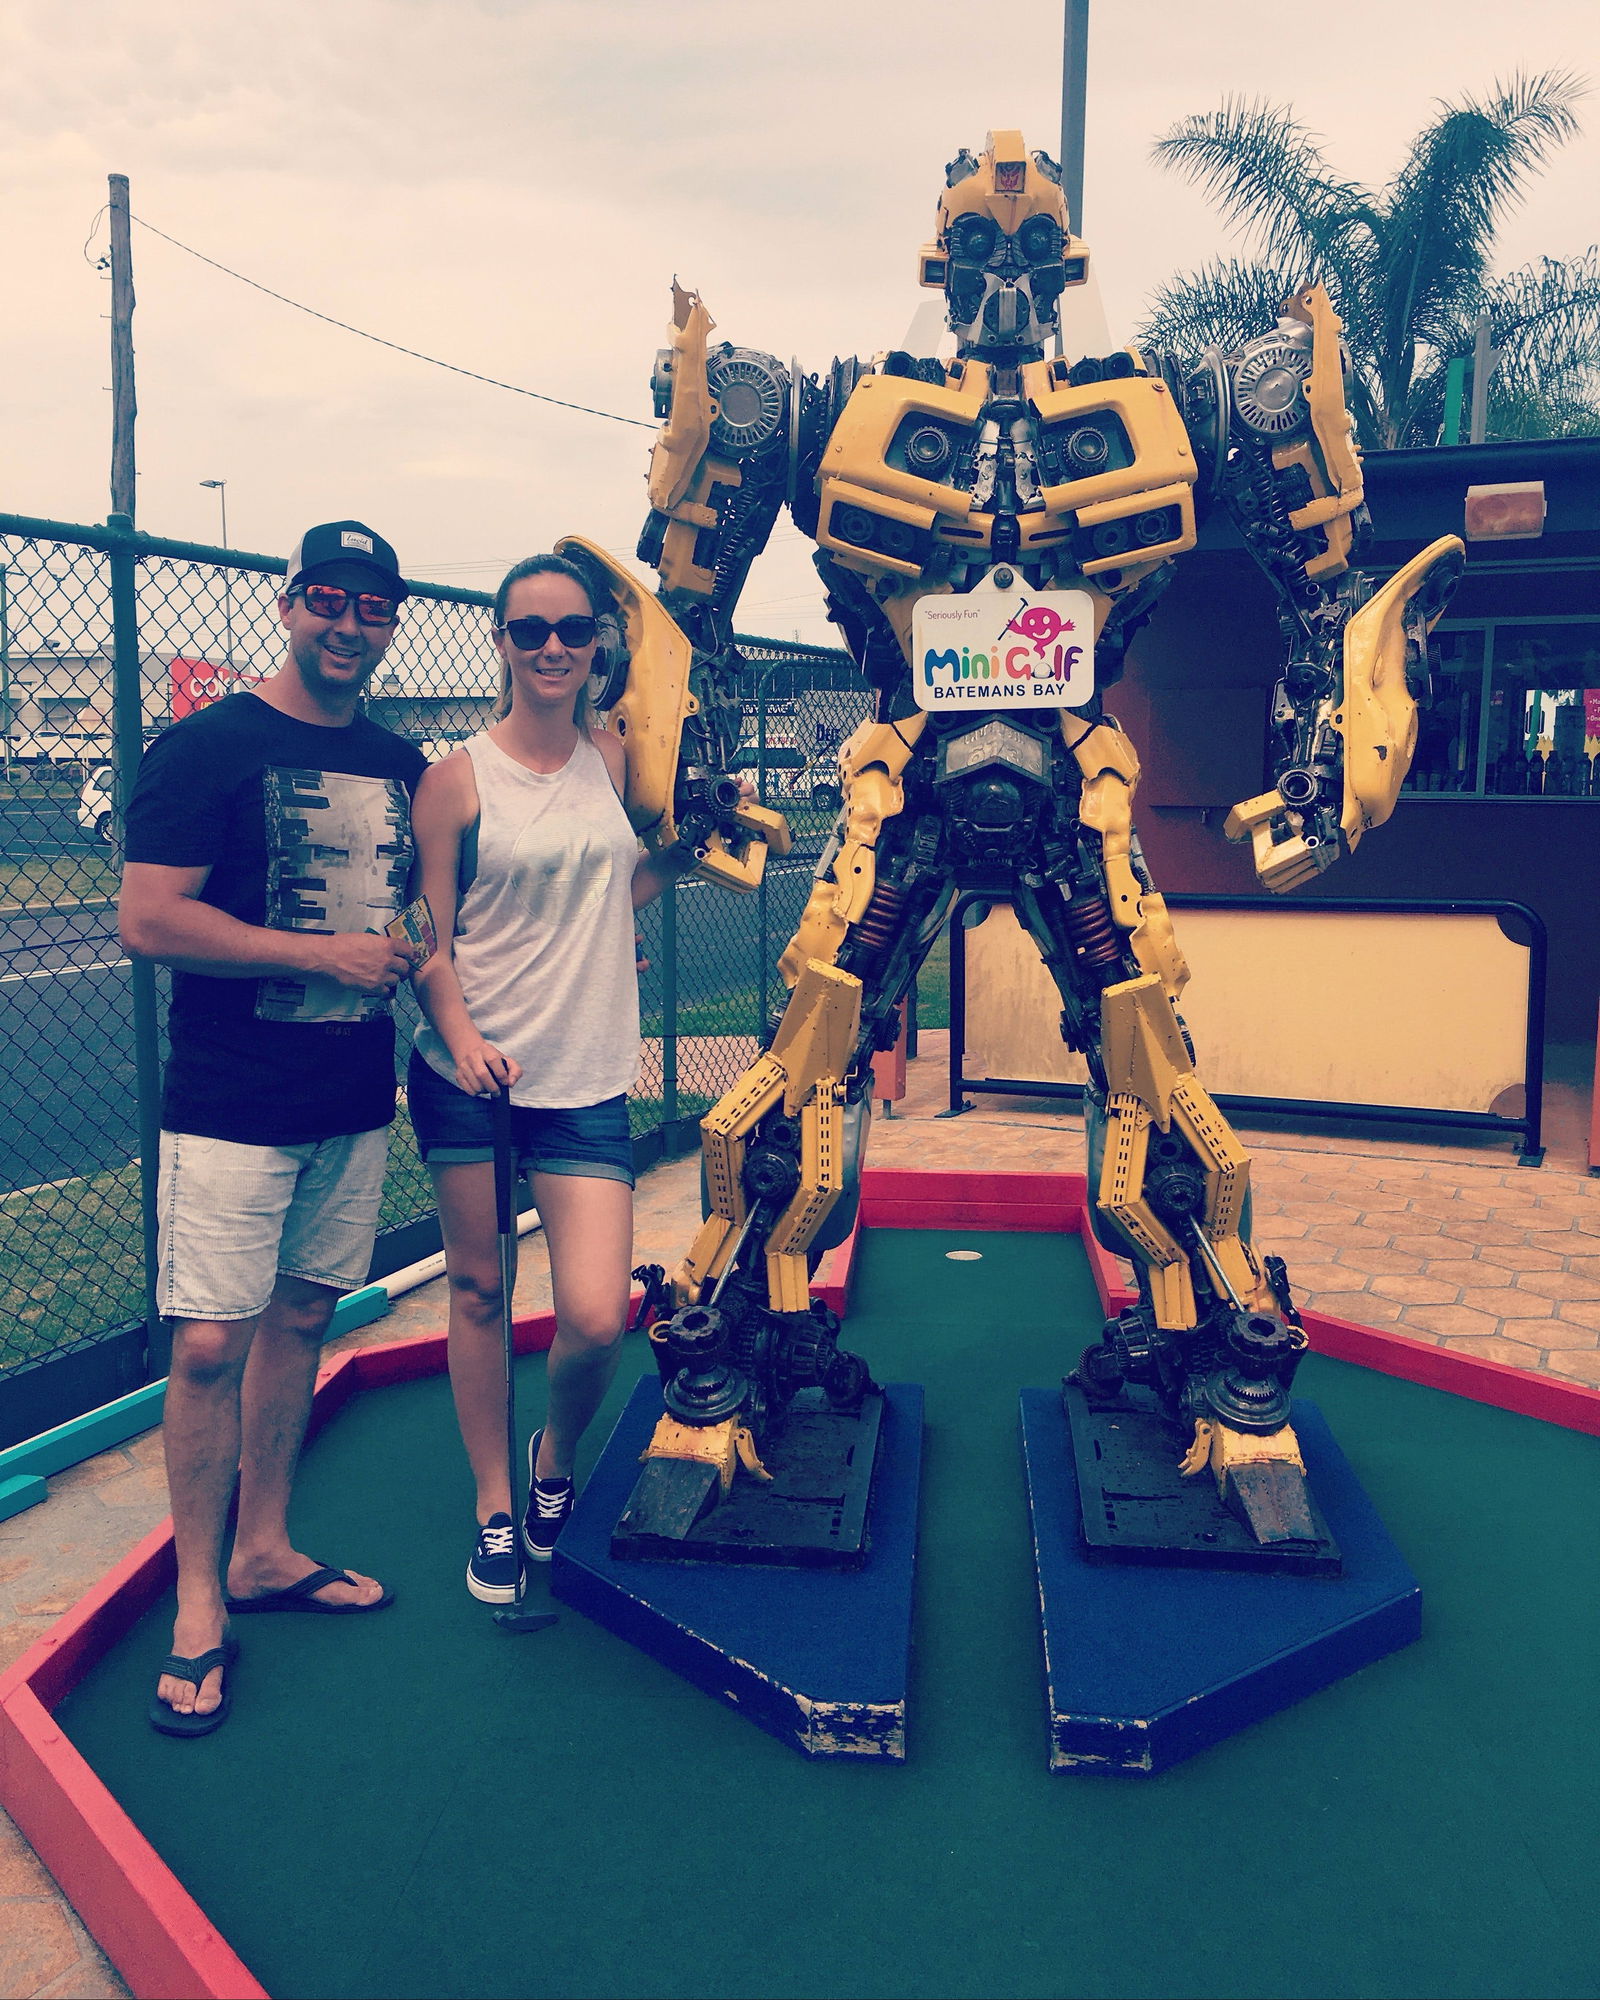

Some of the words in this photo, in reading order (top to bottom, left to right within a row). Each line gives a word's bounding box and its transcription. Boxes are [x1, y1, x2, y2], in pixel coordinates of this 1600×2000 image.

[924, 610, 963, 620] "Seriously
[963, 609, 981, 618] Fun"
[924, 645, 999, 687] Mini
[934, 684, 1026, 699] BATEMANS
[1033, 683, 1066, 697] BAY
